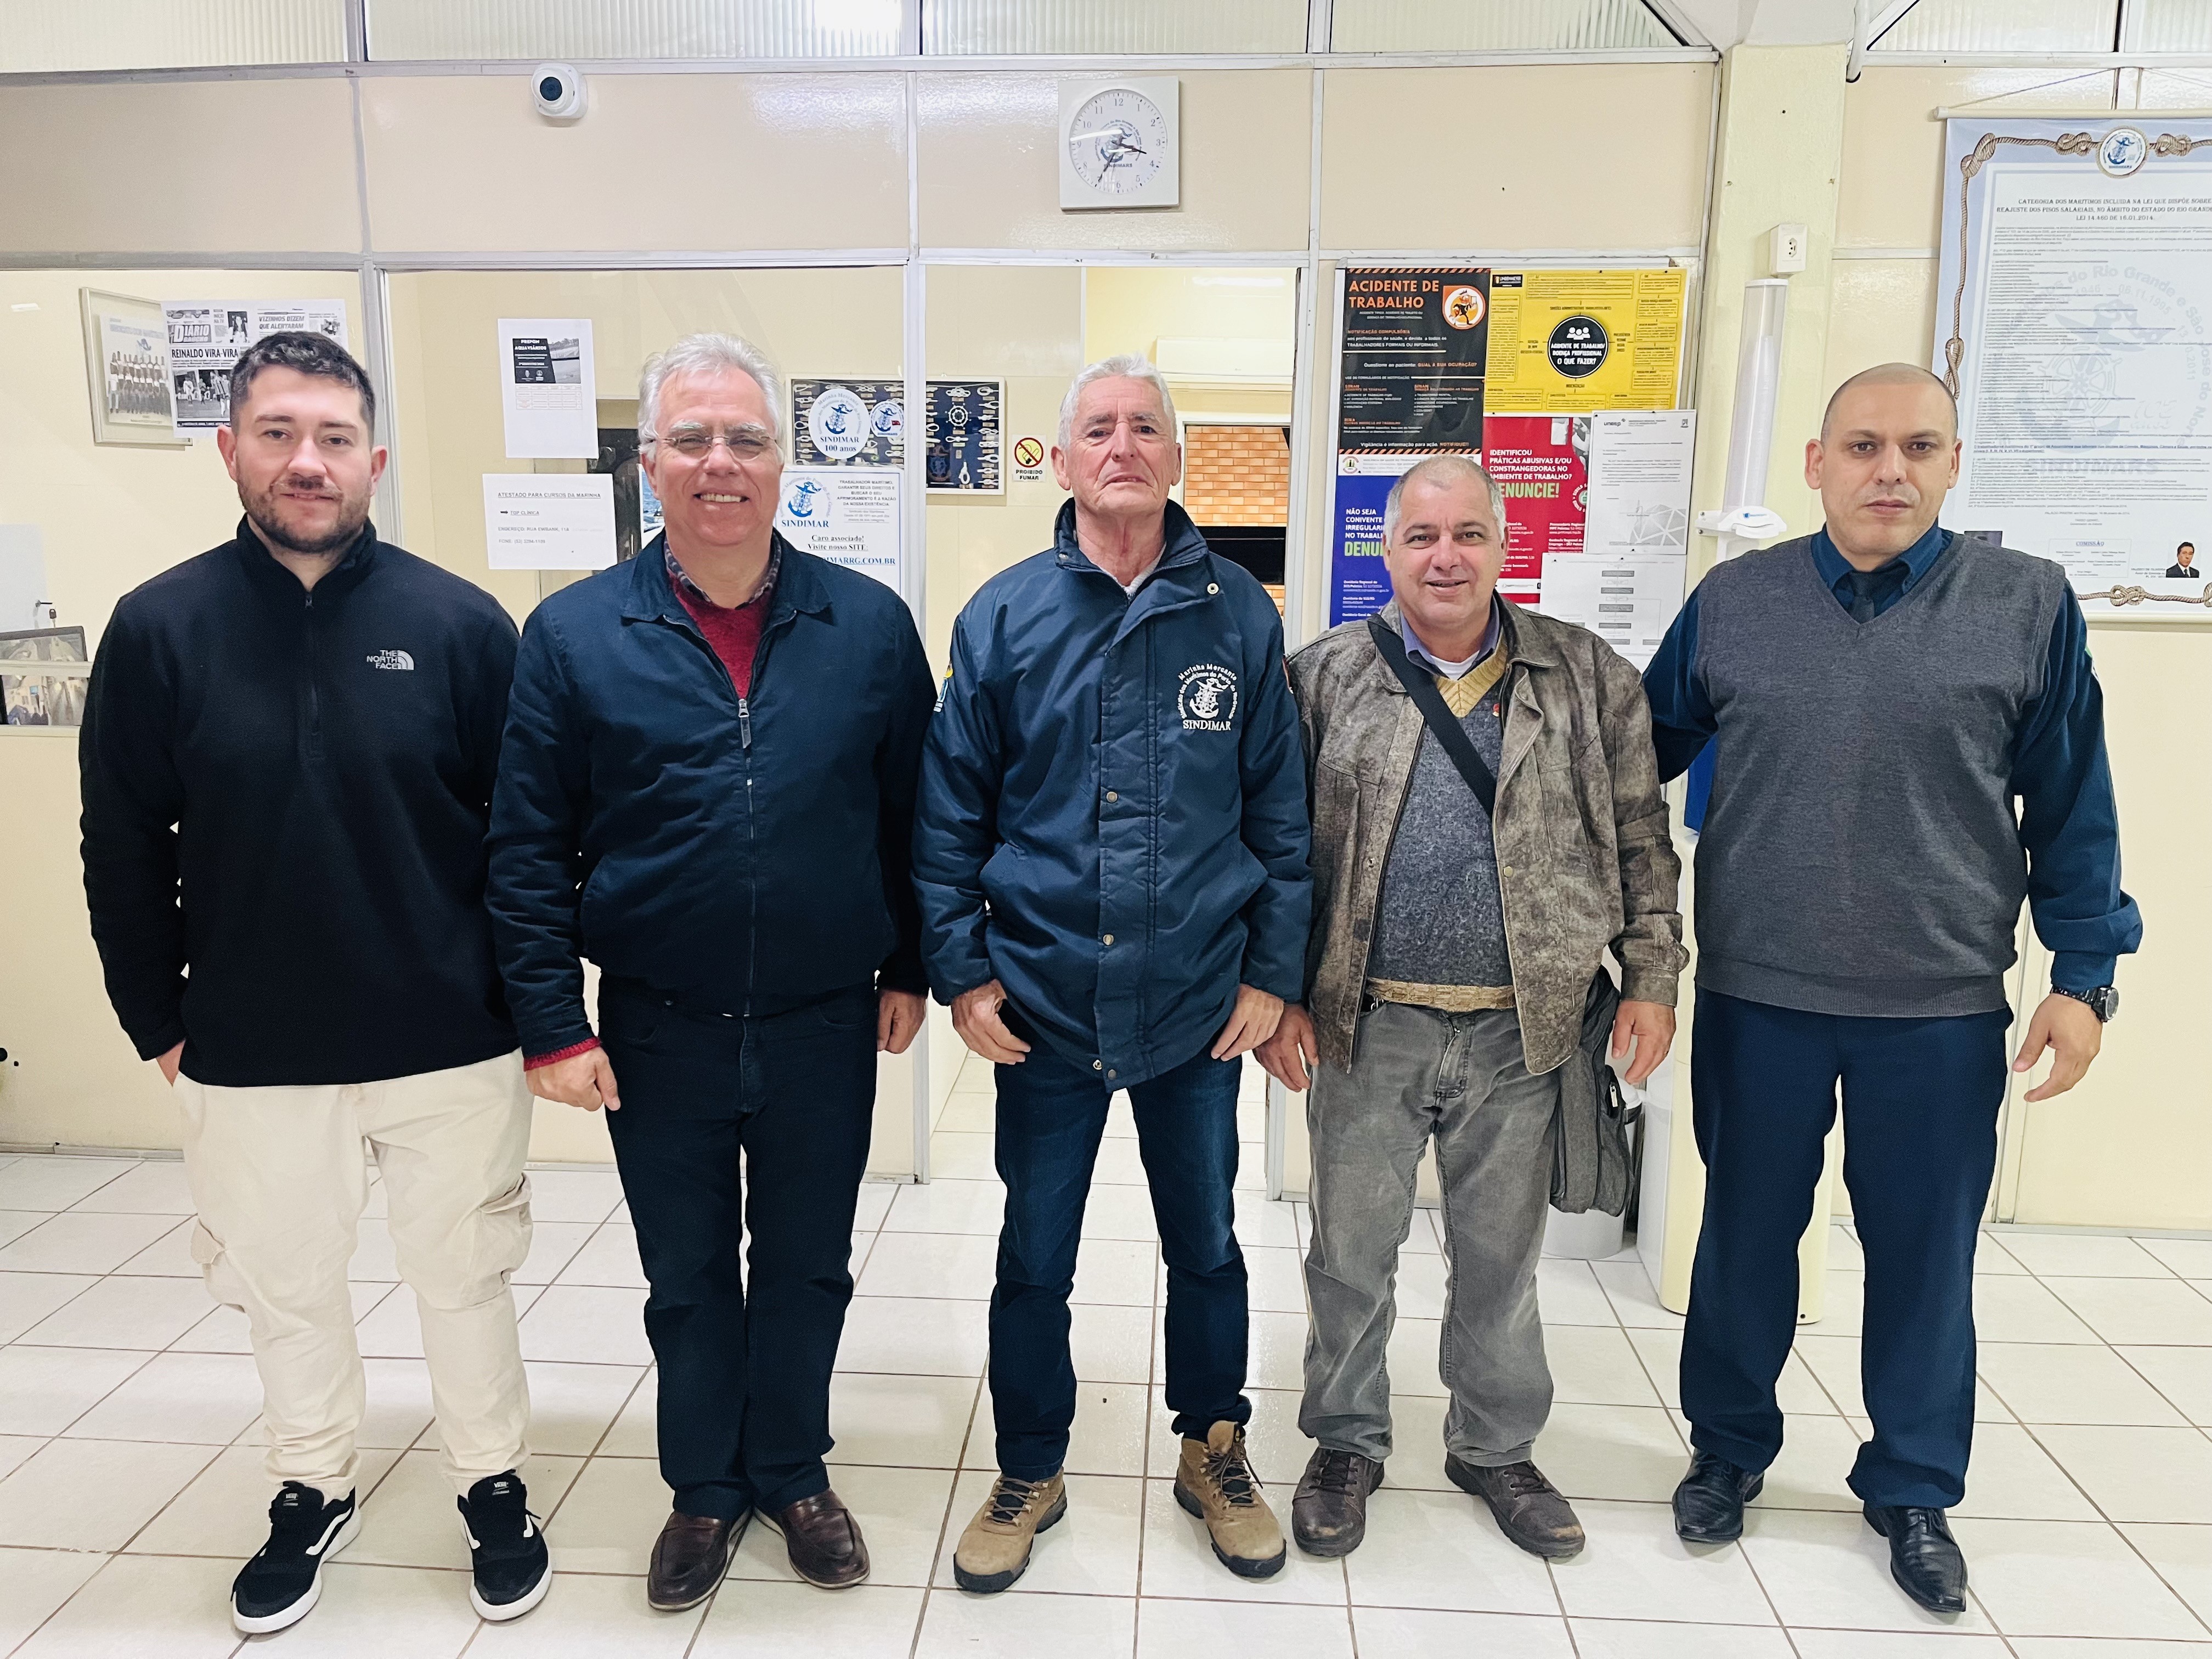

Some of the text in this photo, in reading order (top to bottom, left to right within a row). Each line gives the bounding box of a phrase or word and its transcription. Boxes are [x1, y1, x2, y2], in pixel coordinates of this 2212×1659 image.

[1349, 280, 1439, 292] ACIDENTE DE
[2068, 270, 2087, 283] do
[2093, 265, 2118, 279] Rio
[2124, 266, 2175, 297] Grande
[1349, 296, 1424, 308] TRABALHO
[2118, 284, 2171, 314] 06.11.1995
[172, 348, 238, 358] REINALDO VIRA-VIRA
[1489, 456, 1521, 464] PRÁTICAS
[1498, 482, 1560, 498] ENUNCIE!
[782, 520, 830, 528] SINDIMAR
[1178, 663, 1237, 681] Marinha Mercante
[1217, 673, 1231, 685] Porto
[1182, 719, 1231, 731] SINDIMAR
